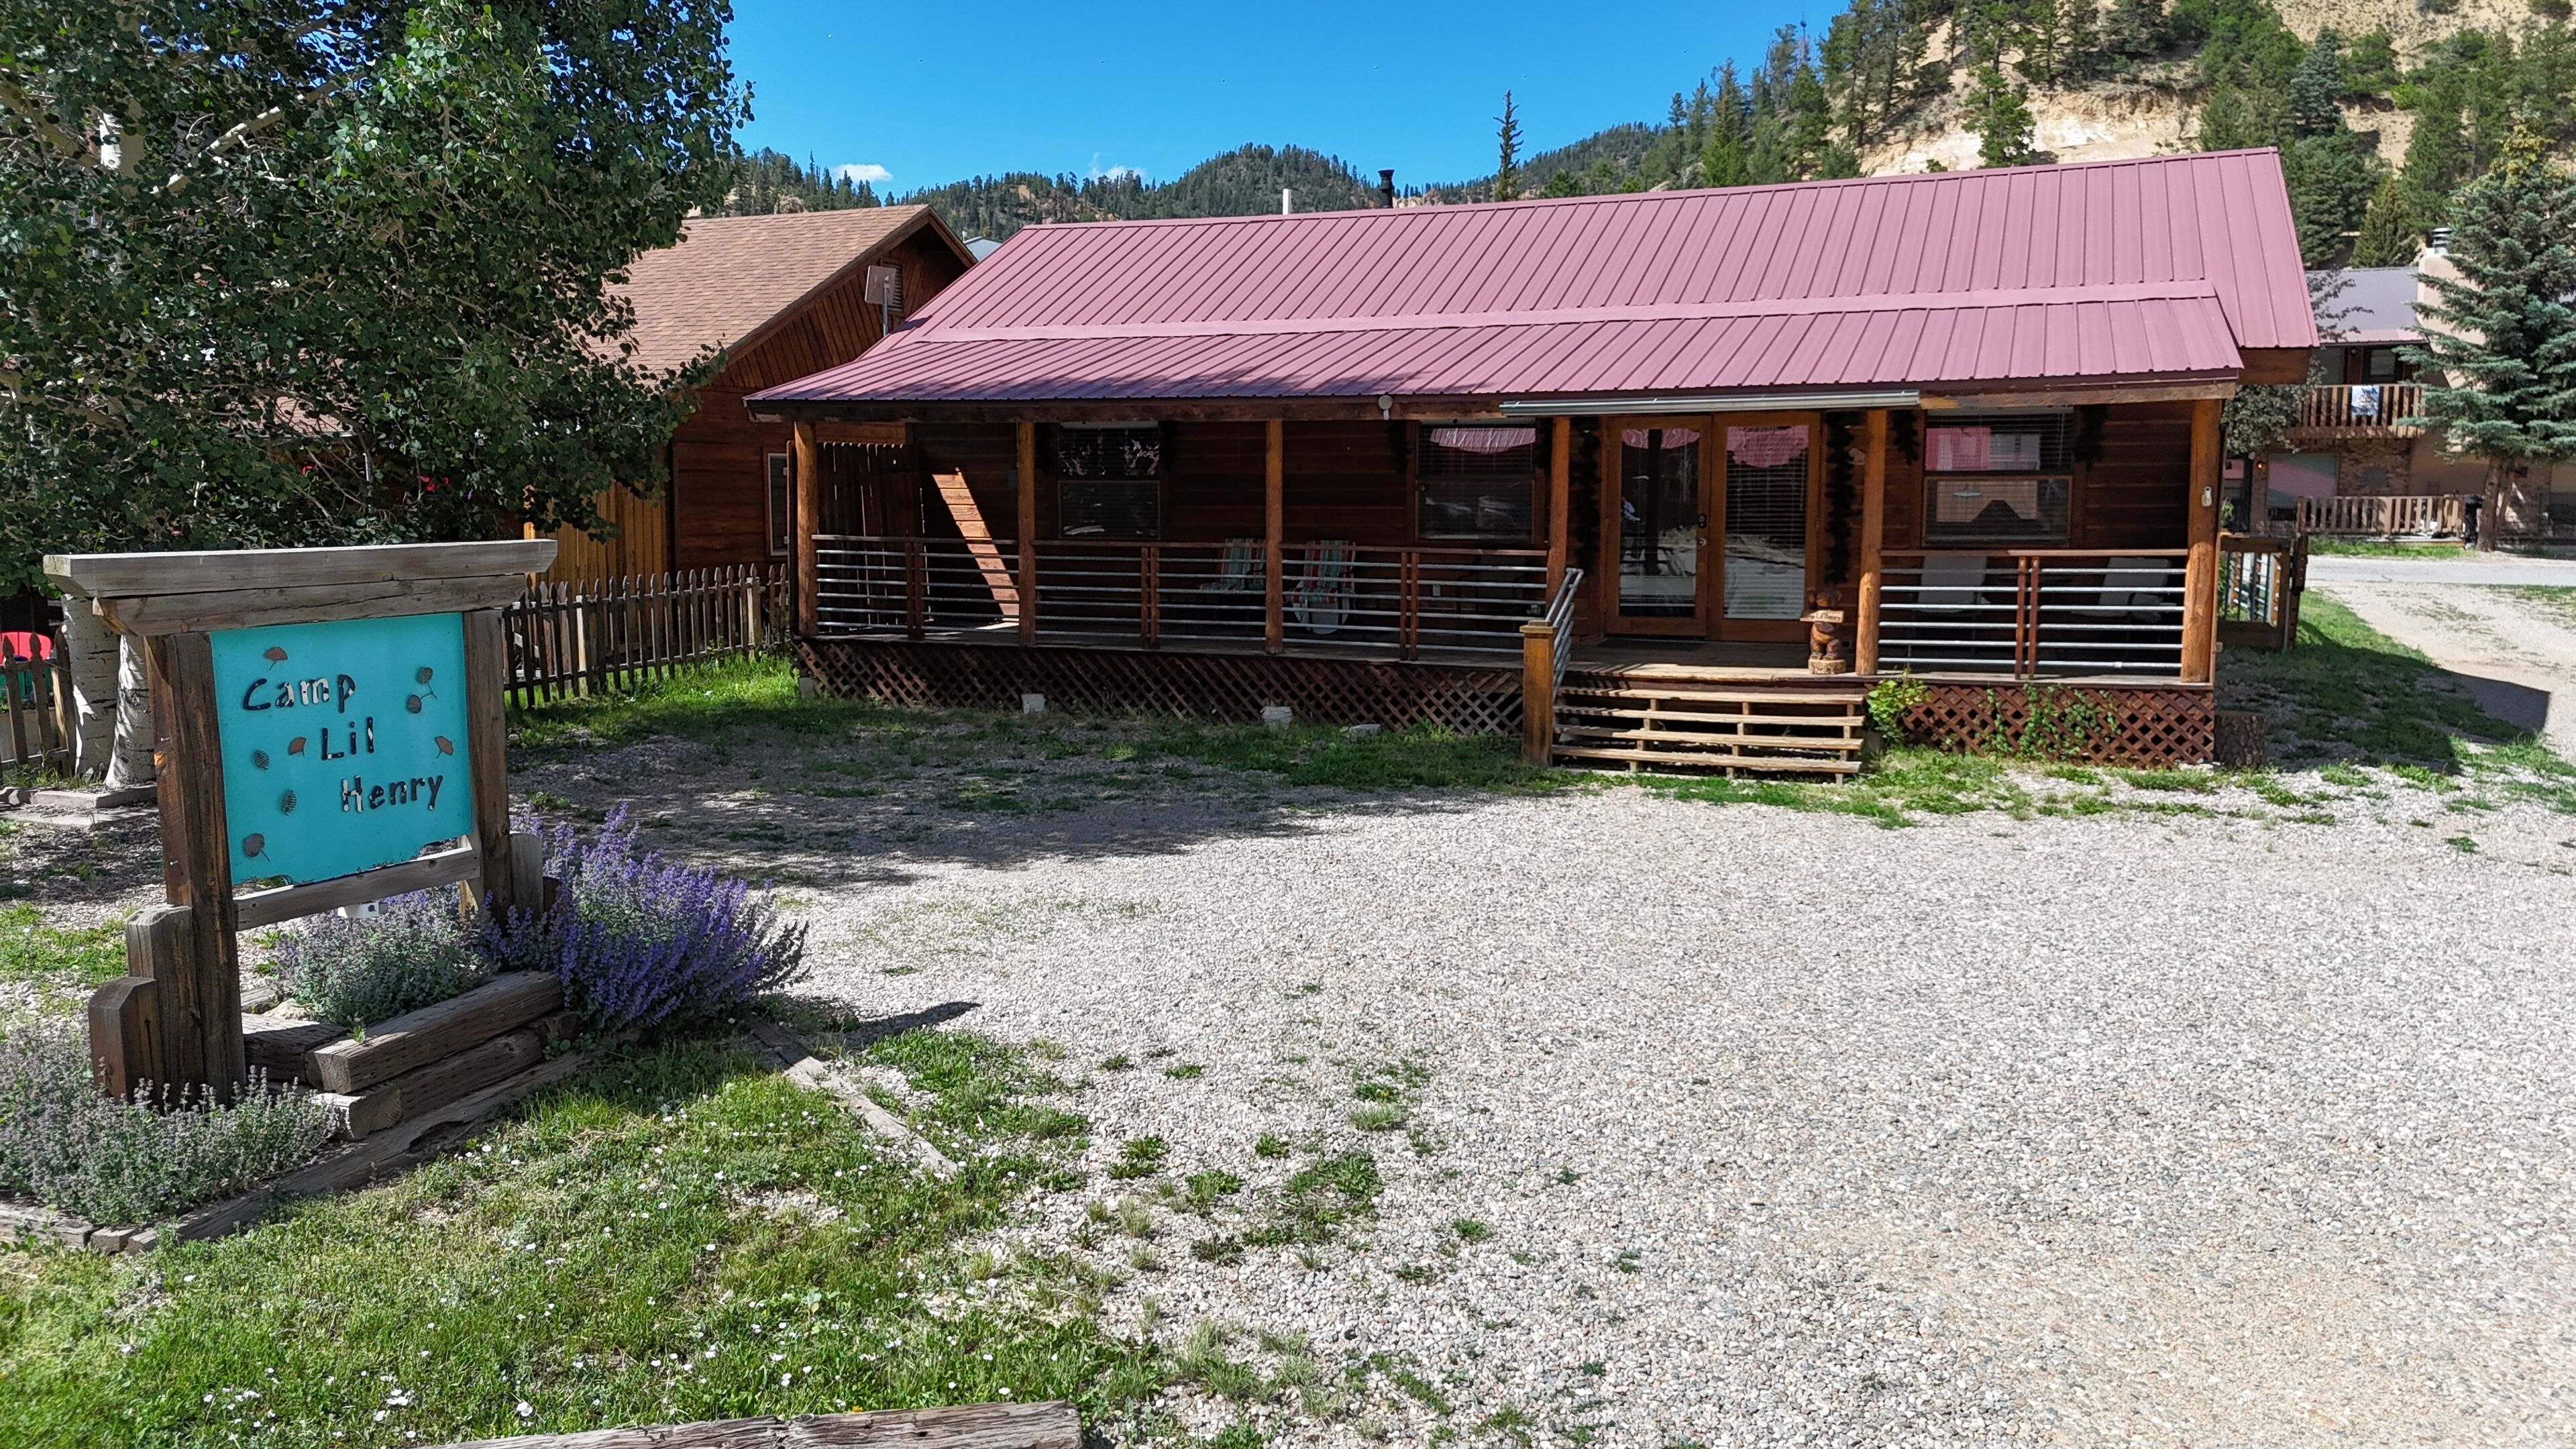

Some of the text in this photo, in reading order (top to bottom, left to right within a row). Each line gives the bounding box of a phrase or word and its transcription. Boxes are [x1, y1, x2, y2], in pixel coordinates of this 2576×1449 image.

[242, 674, 356, 713] Camp
[321, 716, 375, 761] Lil
[340, 775, 443, 813] Henry
